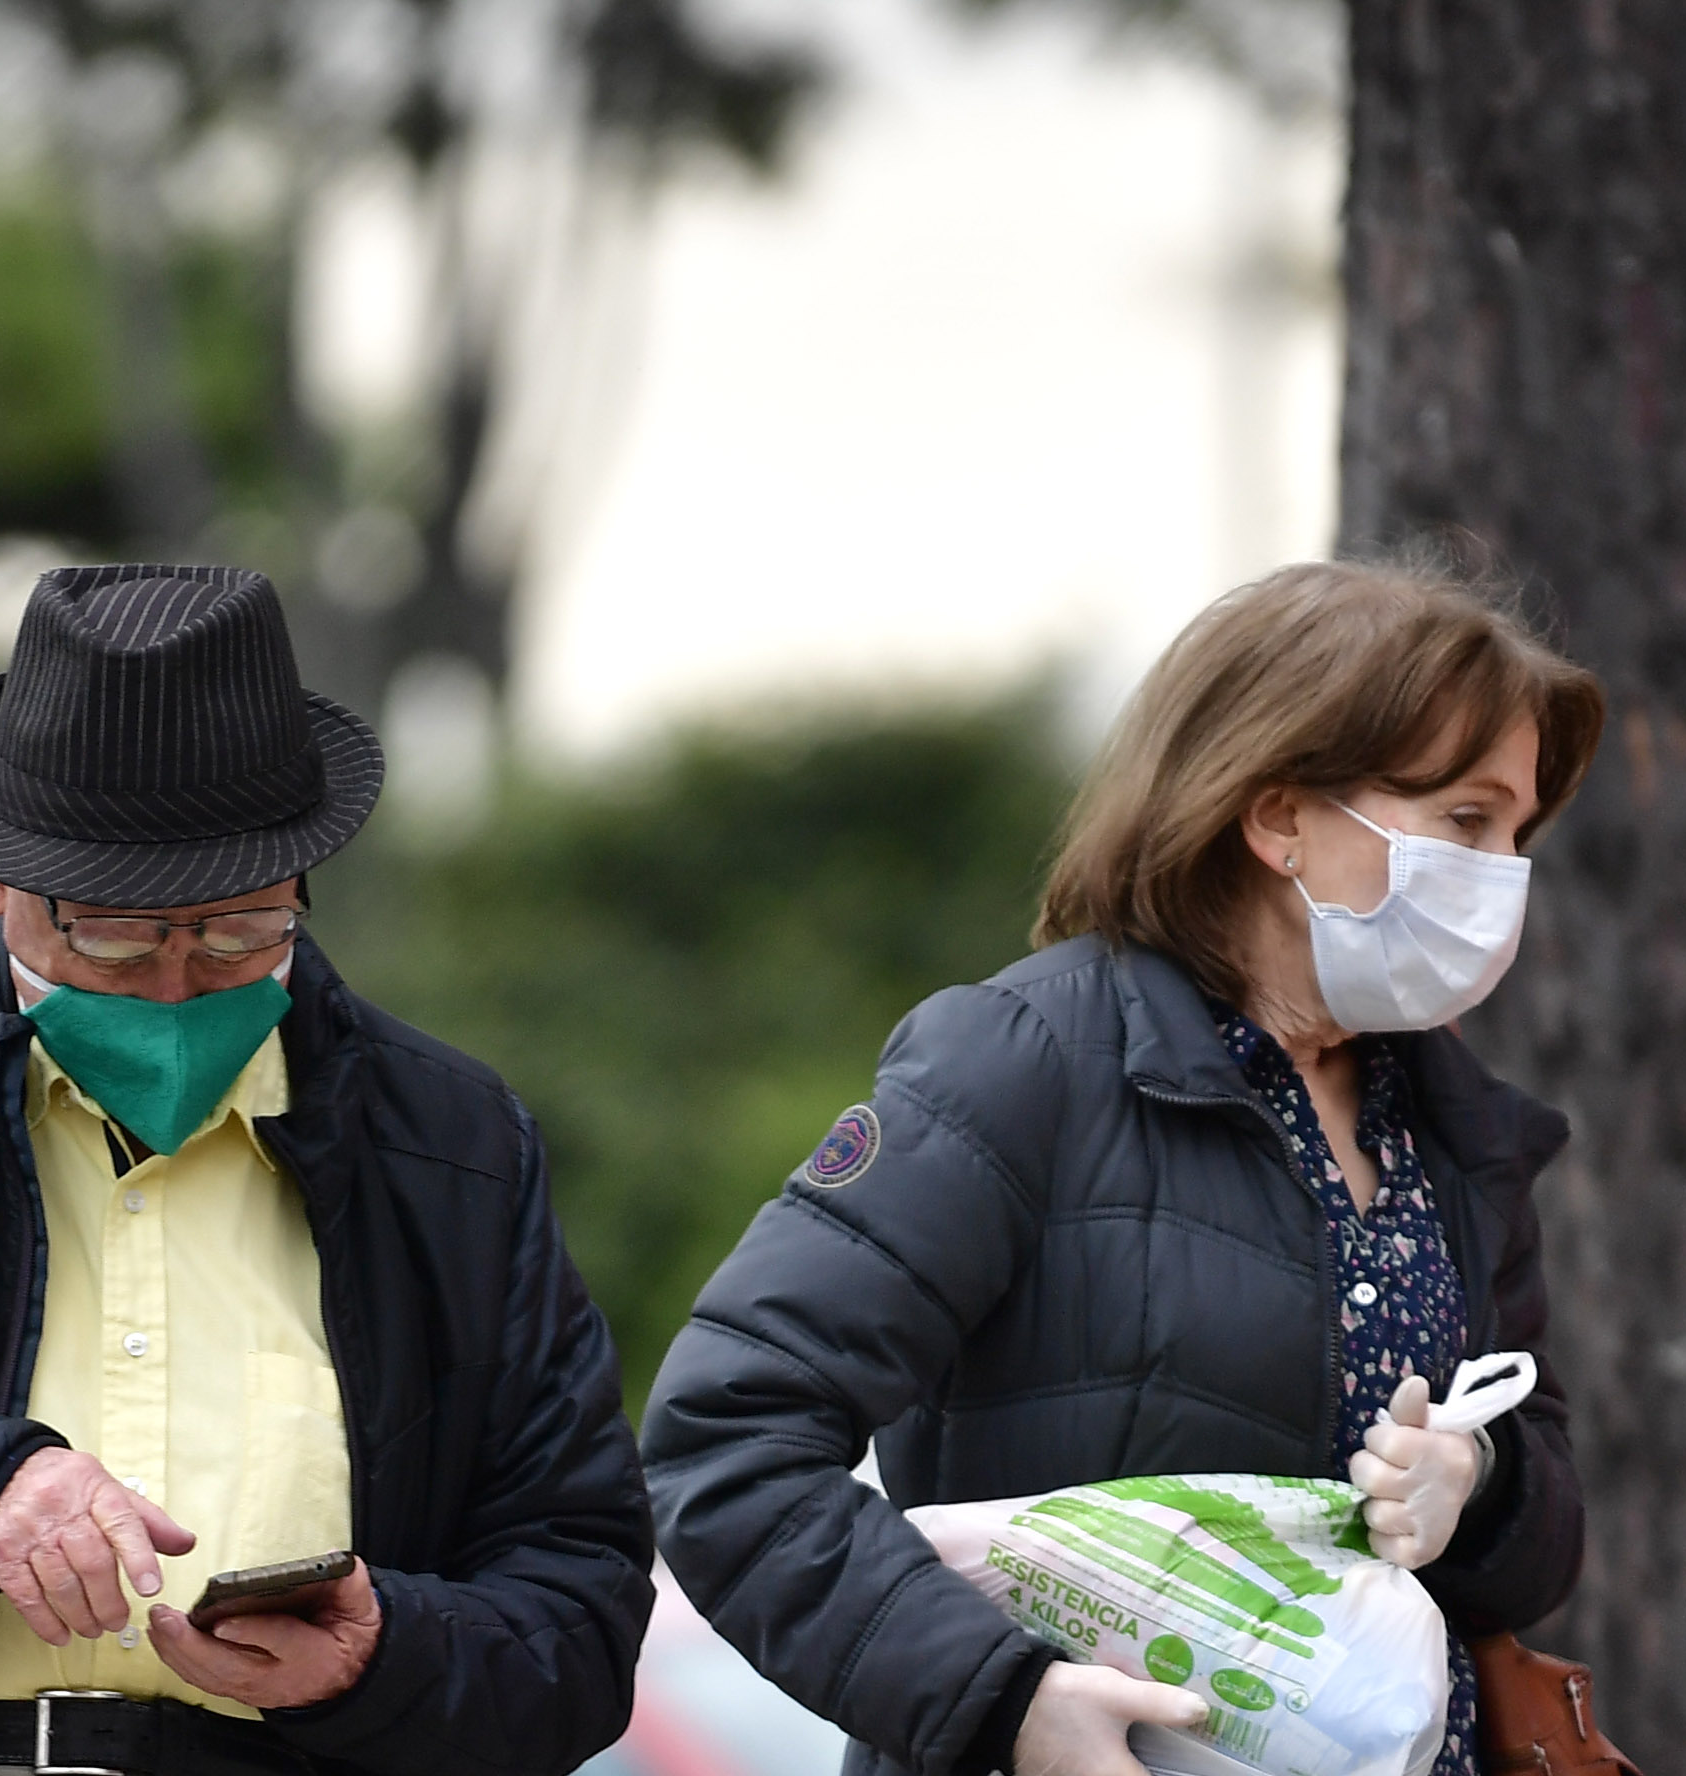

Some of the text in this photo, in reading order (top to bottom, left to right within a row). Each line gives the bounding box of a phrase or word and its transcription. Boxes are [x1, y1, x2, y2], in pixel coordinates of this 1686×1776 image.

[985, 1546, 1138, 1640] RESISTENCIA
[1008, 1586, 1022, 1604] 4
[1030, 1596, 1100, 1647] KILOS
